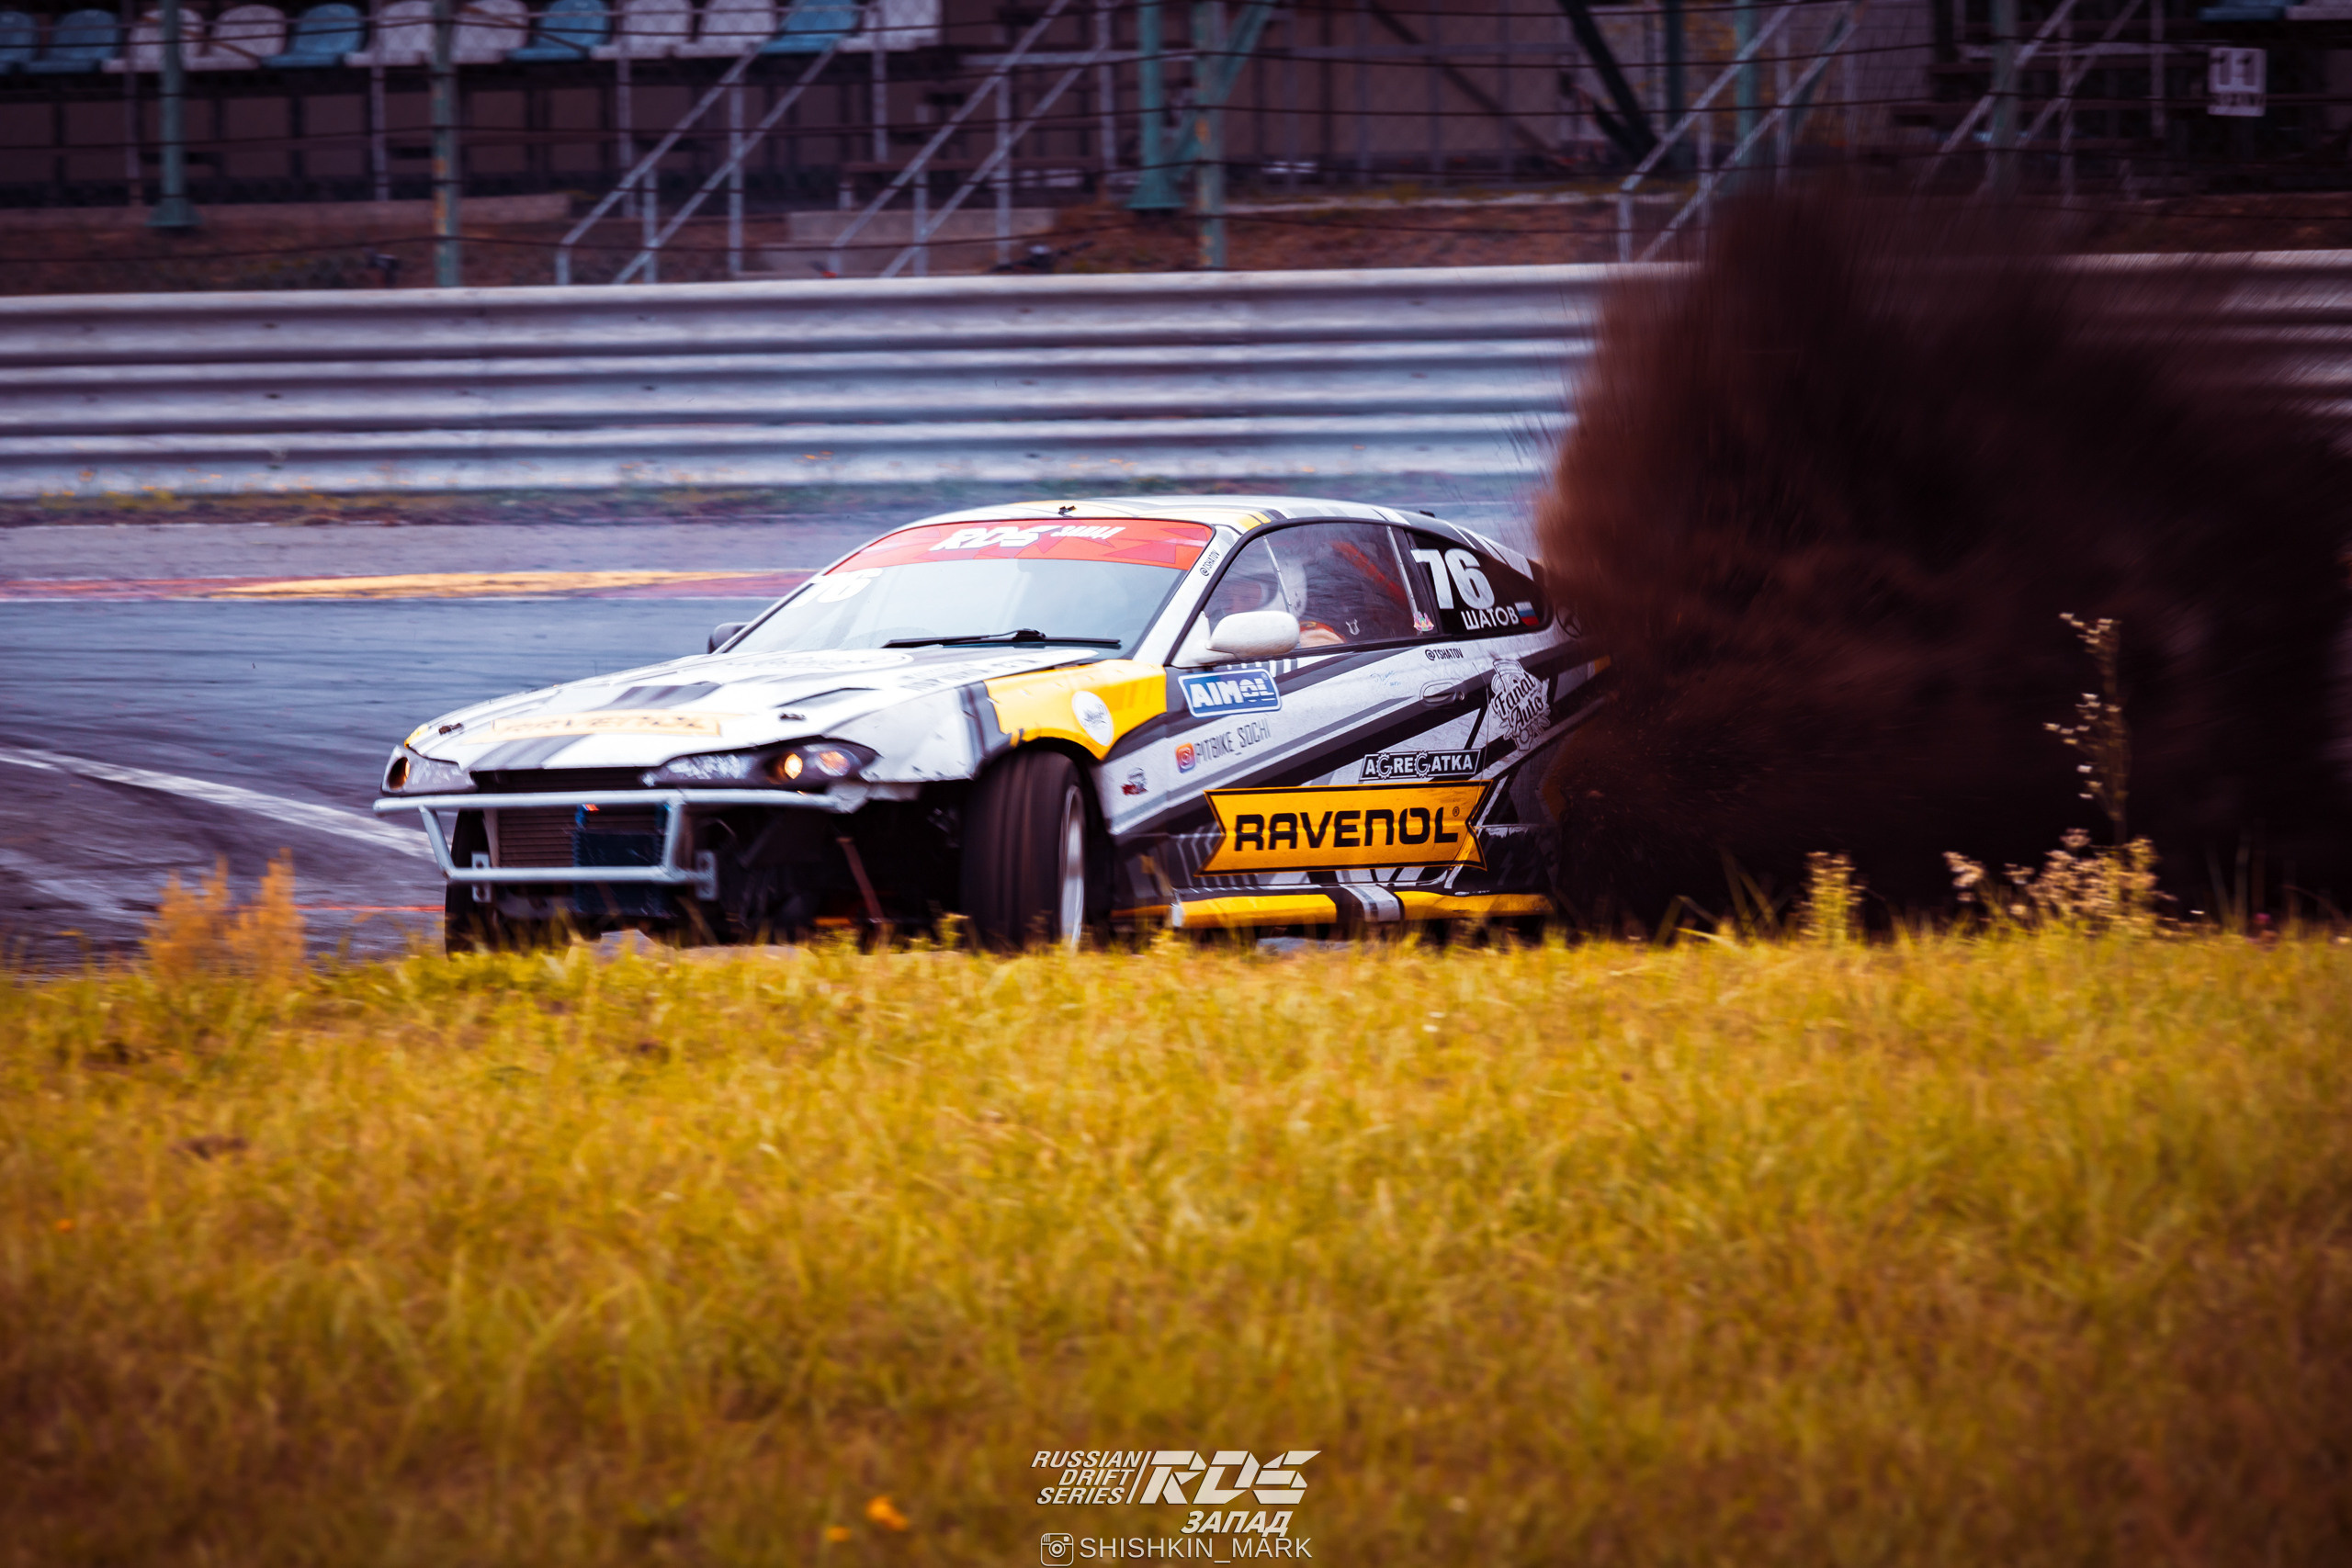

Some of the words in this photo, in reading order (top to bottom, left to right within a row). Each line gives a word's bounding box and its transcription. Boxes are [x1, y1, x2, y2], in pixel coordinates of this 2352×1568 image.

[783, 567, 884, 611] 76
[1411, 548, 1495, 609] 76
[1461, 606, 1519, 630] ШАТОВ
[1425, 649, 1464, 660] @TSHATOV
[1190, 678, 1276, 708] AIMOL
[1495, 671, 1536, 716] Fanat
[1511, 696, 1544, 735] Auto
[1195, 718, 1271, 764] PITBIKE_SOCHI
[1365, 751, 1473, 779] AGREGATKA
[1235, 807, 1459, 852] RAVENOL
